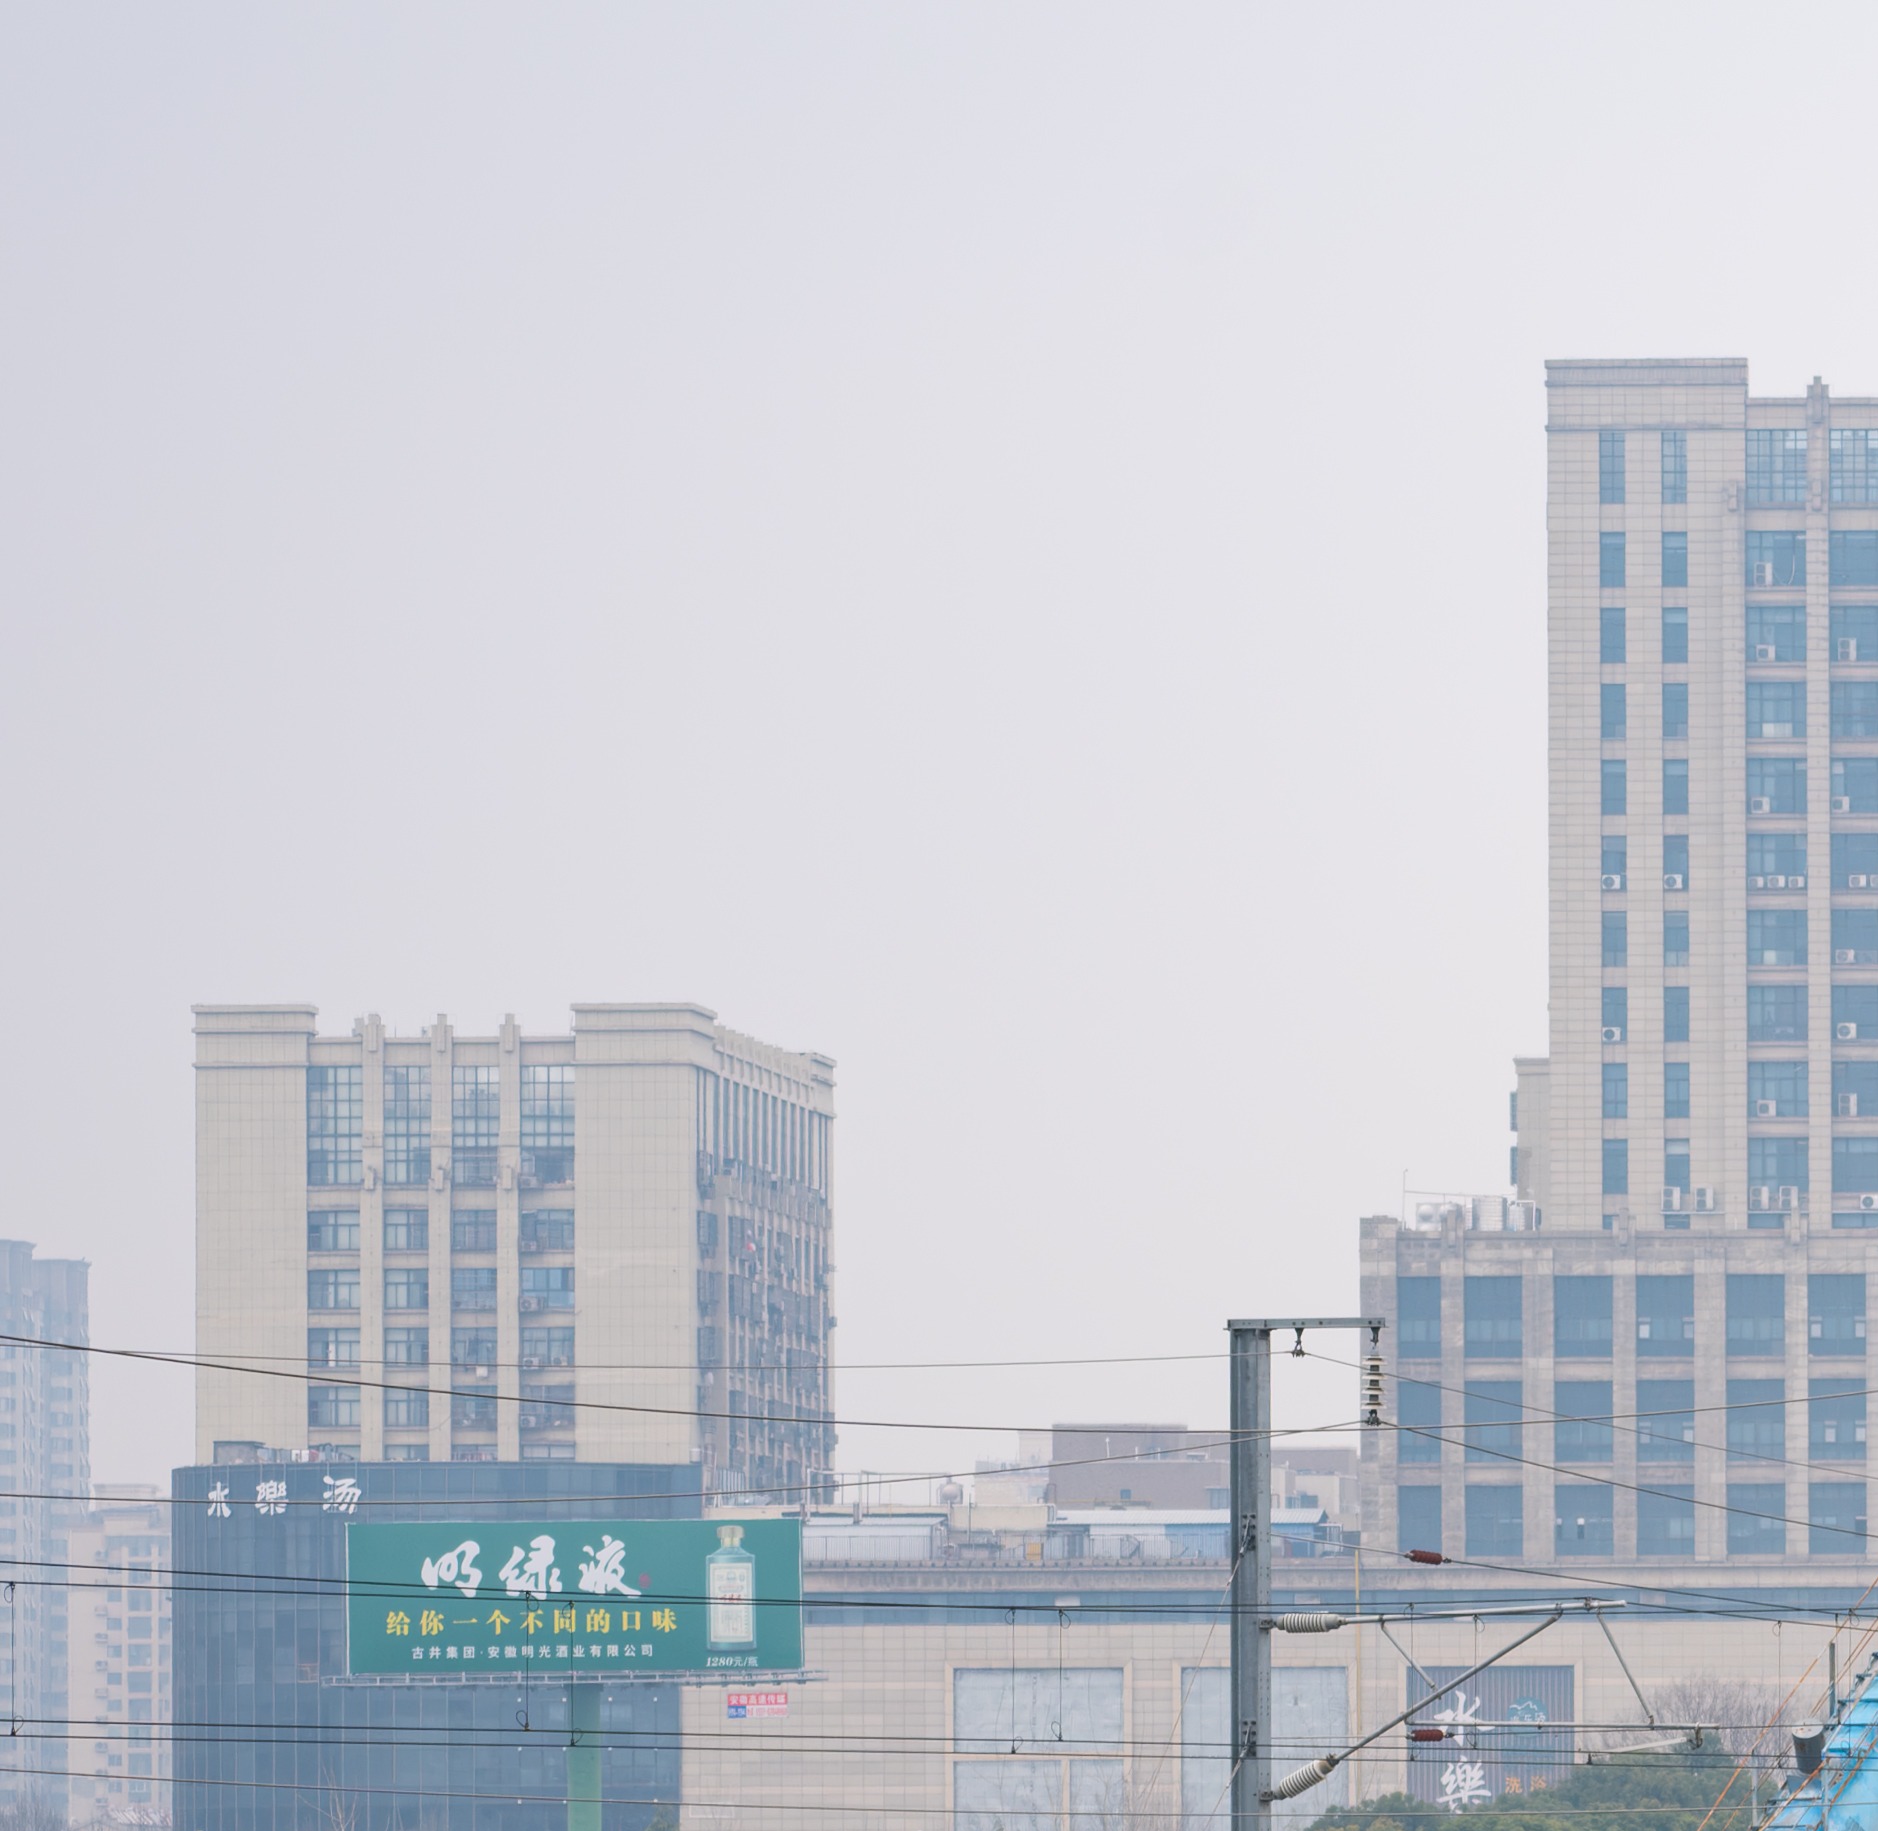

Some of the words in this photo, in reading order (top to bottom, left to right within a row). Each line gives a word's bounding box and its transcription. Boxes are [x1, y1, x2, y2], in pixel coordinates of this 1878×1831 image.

[386, 1608, 678, 1636] 给你一个不同的口味
[411, 1644, 654, 1660] 古井集团·安徽明光酒业有限公司
[1505, 1776, 1547, 1794] 洗浴
